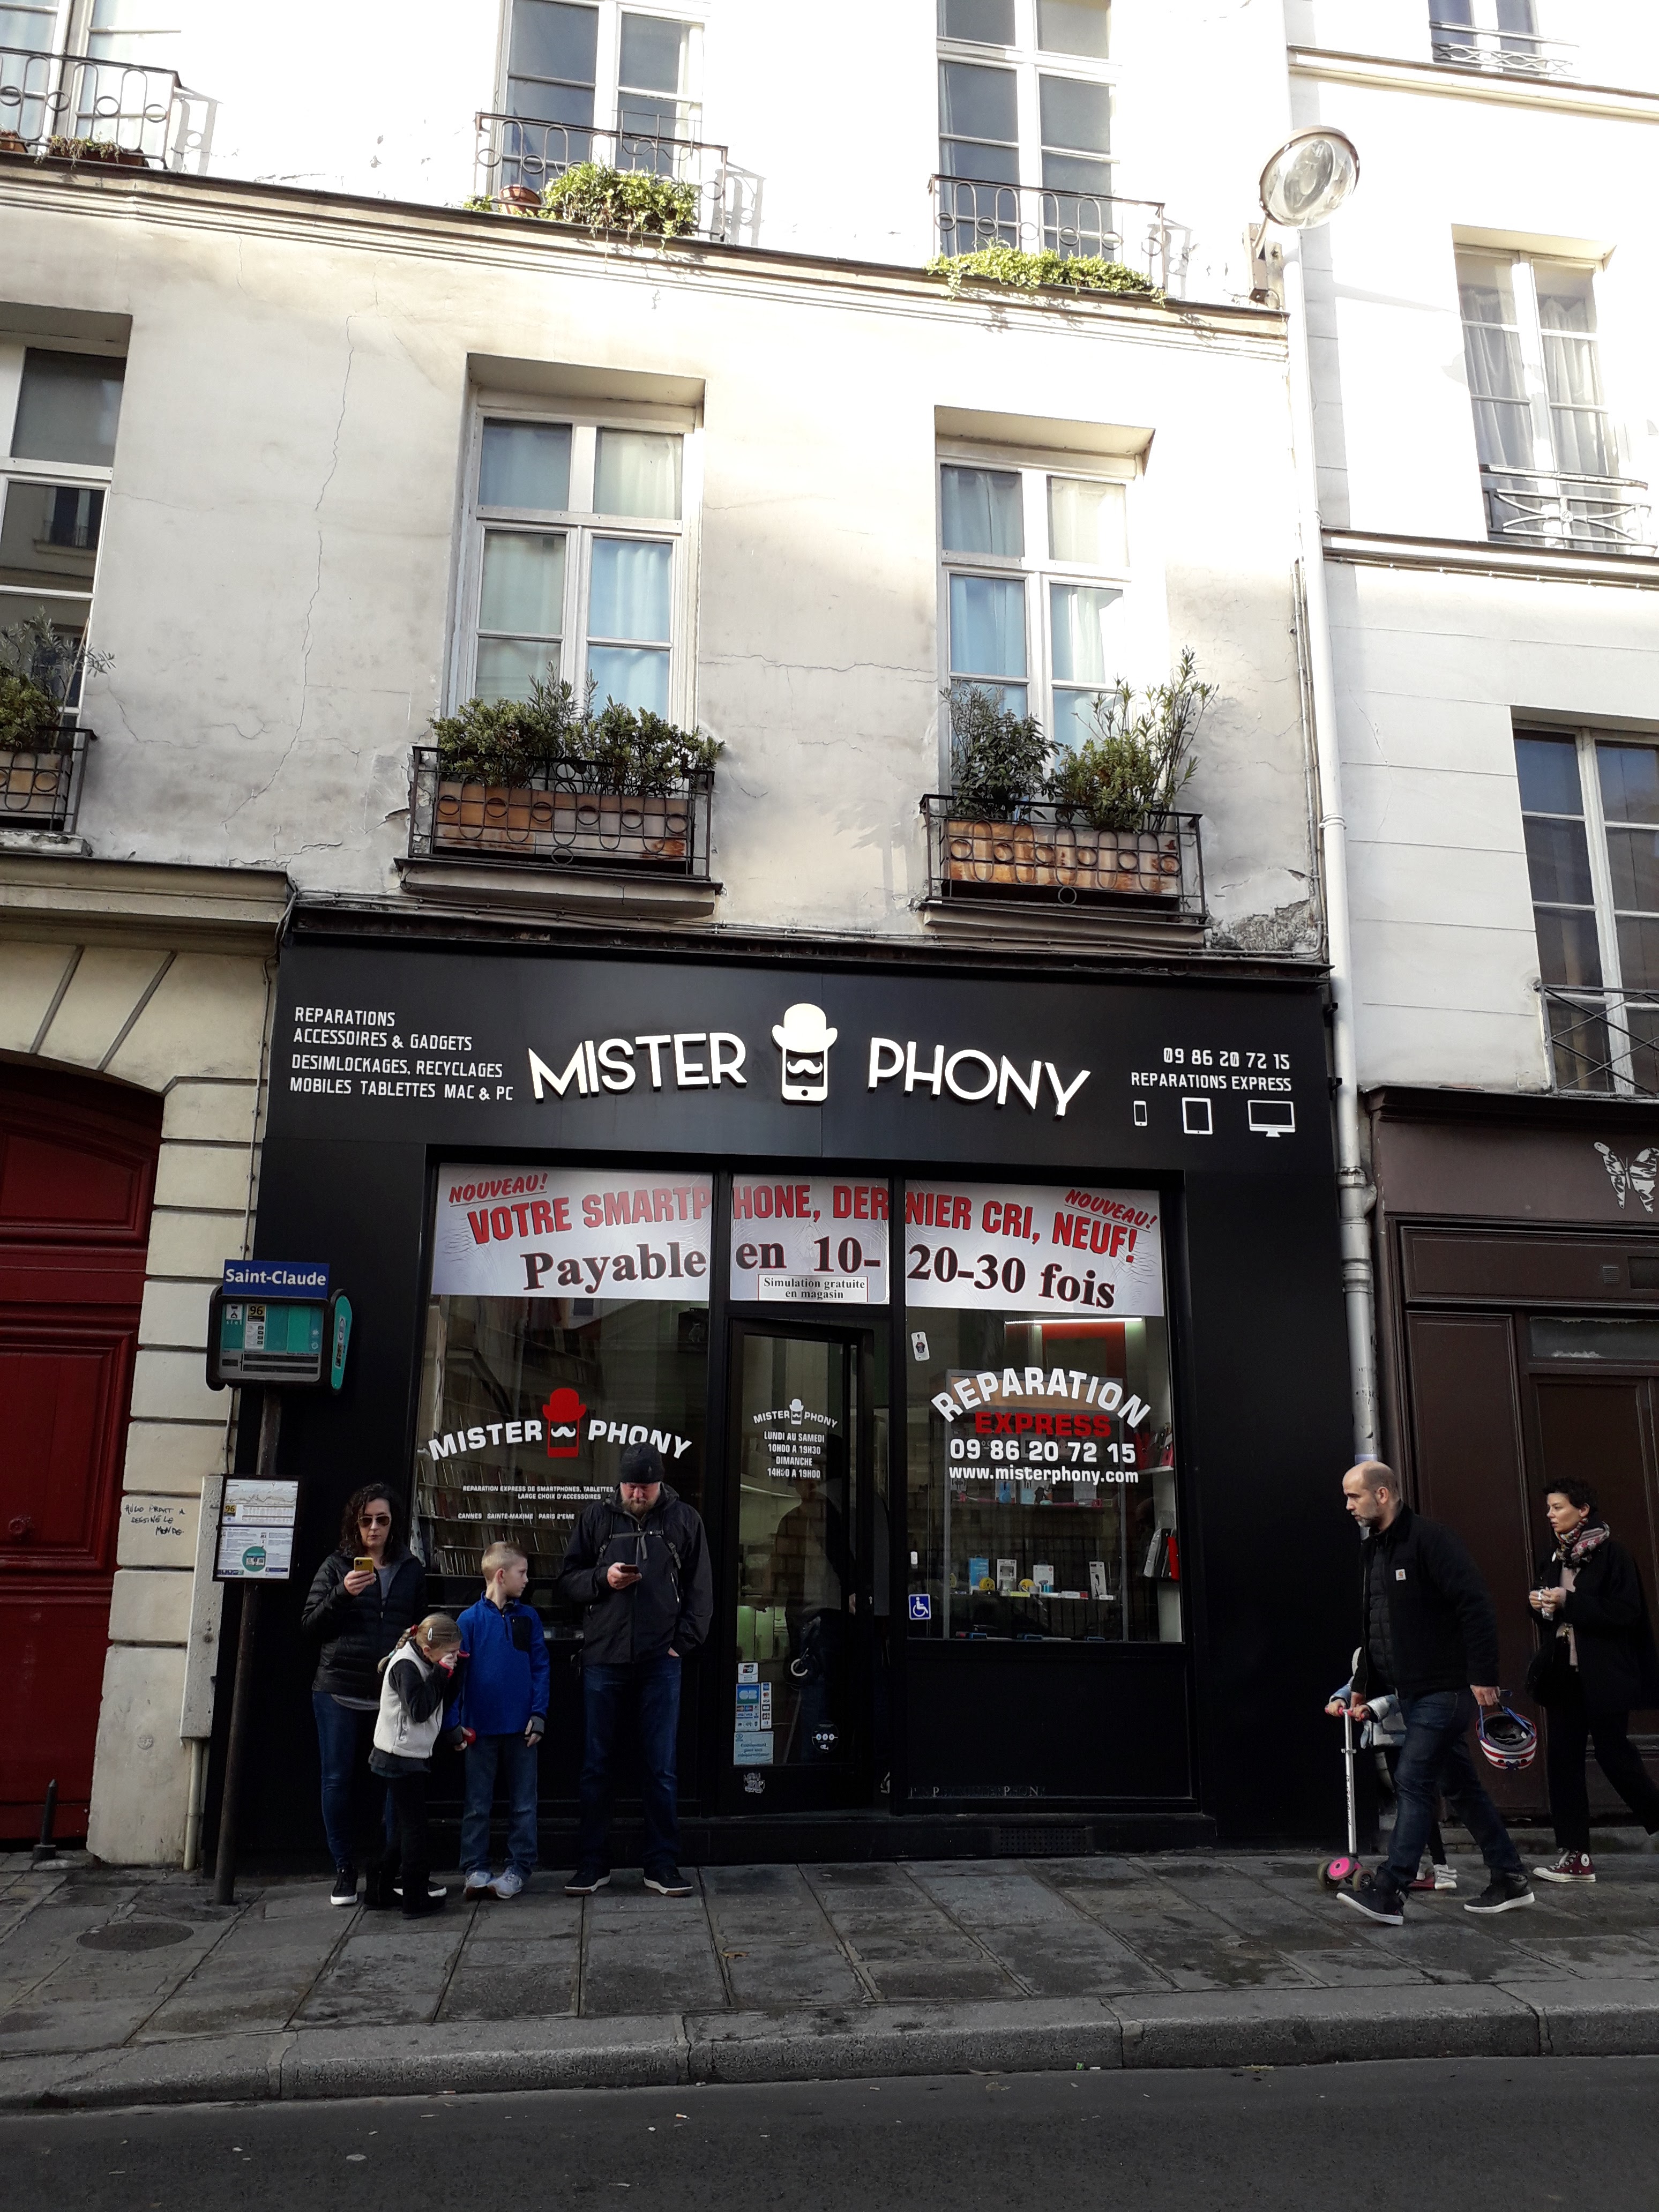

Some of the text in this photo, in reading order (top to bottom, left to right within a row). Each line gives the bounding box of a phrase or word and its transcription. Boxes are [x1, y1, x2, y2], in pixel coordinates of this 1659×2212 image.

[295, 1007, 395, 1027] REPARATIONS
[293, 1028, 472, 1051] ACCESSOIRES & GADGETS
[292, 1054, 503, 1078] DESIMLOCKAGES, RECYCLAGES
[1163, 1047, 1290, 1070] 09 86 20 72 15
[528, 1032, 1091, 1118] MISTER PHONY
[1131, 1072, 1291, 1091] REPARATIONS EXPRESS
[289, 1077, 513, 1101] MOBILES TABLETTES MAC & PC
[449, 1172, 548, 1204] NOUVEAU!
[1064, 1189, 1157, 1229] NOUVEAU!
[468, 1197, 572, 1245] VOTRE
[982, 1200, 1040, 1245] CRI,
[1052, 1212, 1137, 1263] NEUF!
[226, 1268, 326, 1286] Saint-Claude
[521, 1242, 707, 1294] Payable
[735, 1242, 787, 1269] en
[907, 1244, 1026, 1293] 20-30
[1038, 1262, 1115, 1309] fois
[764, 1277, 865, 1290] Simulation gratuite
[801, 1289, 843, 1300] magasin
[250, 1305, 263, 1315] 96
[931, 1366, 1150, 1428] REPARATION
[753, 1410, 838, 1428] MISTER PHONY
[975, 1412, 1111, 1437] EXPRESS
[428, 1419, 692, 1461] MISTER PHONY
[764, 1431, 825, 1443] LUNDI AU SAMEDI
[768, 1443, 821, 1455] 10H00 A 19H30
[950, 1439, 1135, 1463] 09 86 20 72 15
[776, 1456, 812, 1466] DIMANCHE
[791, 1469, 796, 1477] A
[798, 1469, 820, 1478] 19H00
[949, 1466, 1138, 1485] www.misterphony.com
